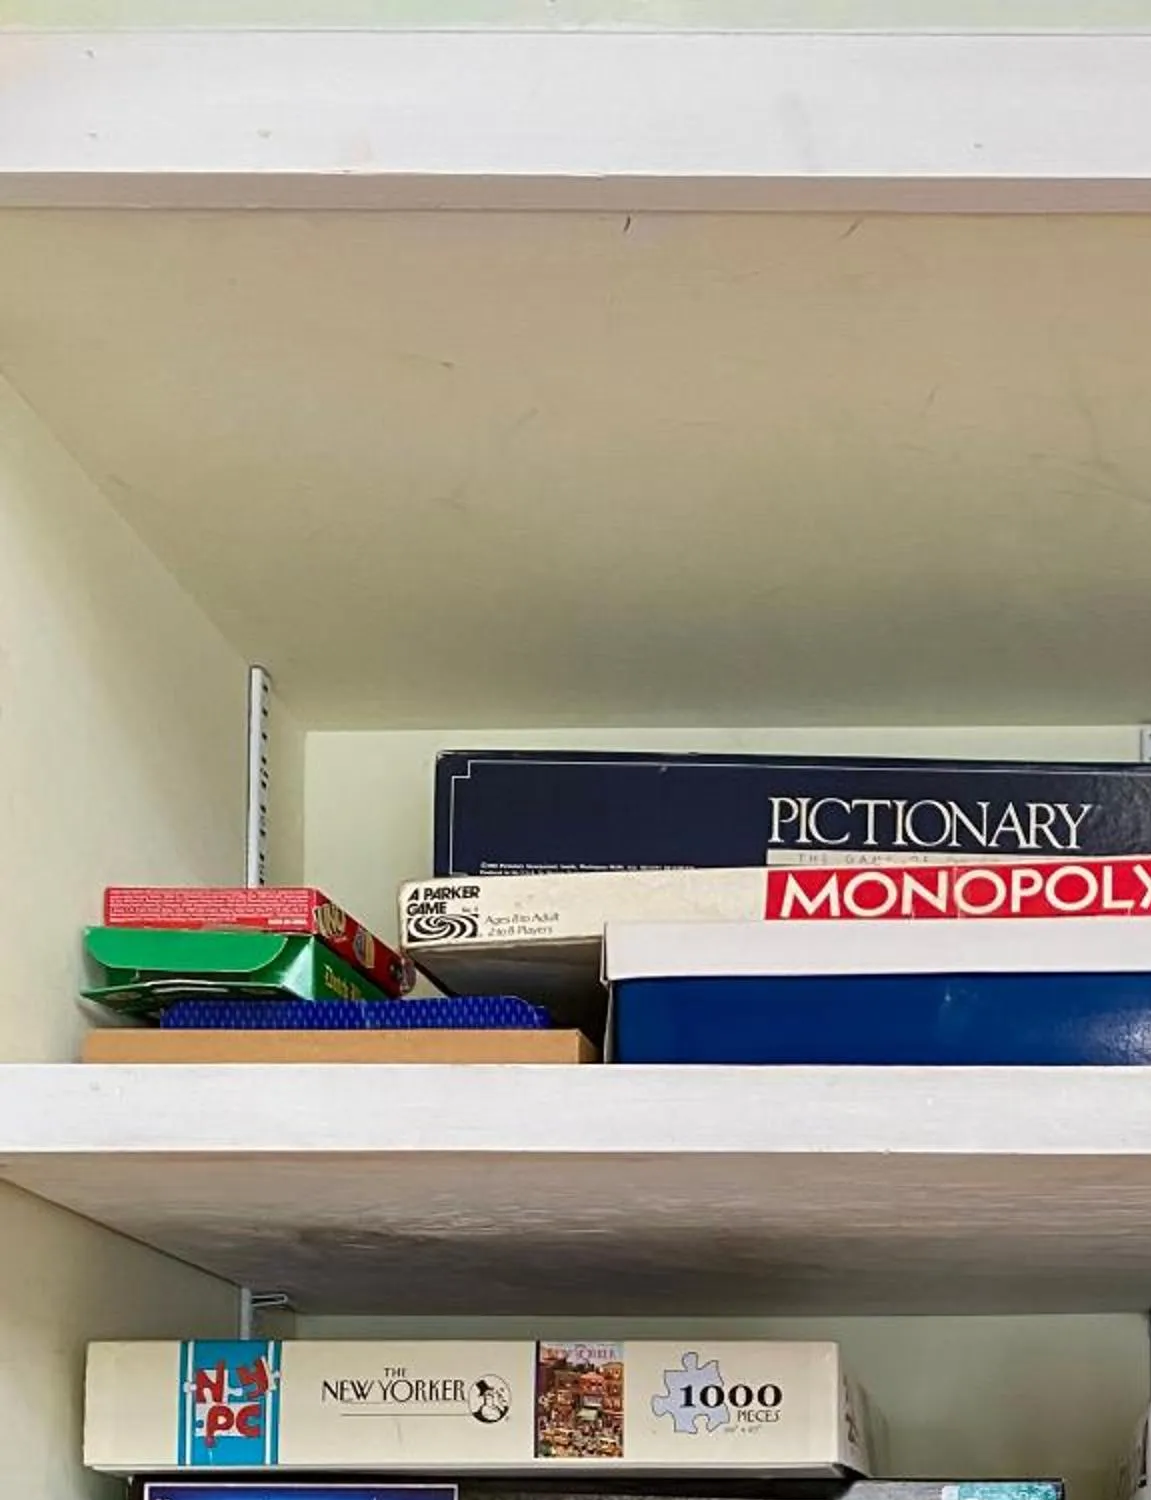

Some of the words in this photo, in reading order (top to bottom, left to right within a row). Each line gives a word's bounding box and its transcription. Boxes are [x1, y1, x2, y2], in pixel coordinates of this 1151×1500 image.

[767, 797, 1093, 849] PICTIONARY
[408, 888, 419, 900] A
[423, 886, 480, 899] PARKER
[407, 902, 447, 915] GAME
[384, 1367, 407, 1377] THE
[321, 1380, 374, 1402] NEW
[376, 1380, 466, 1403] YORKER
[678, 1384, 783, 1409] 1000
[737, 1409, 782, 1423] PIECES
